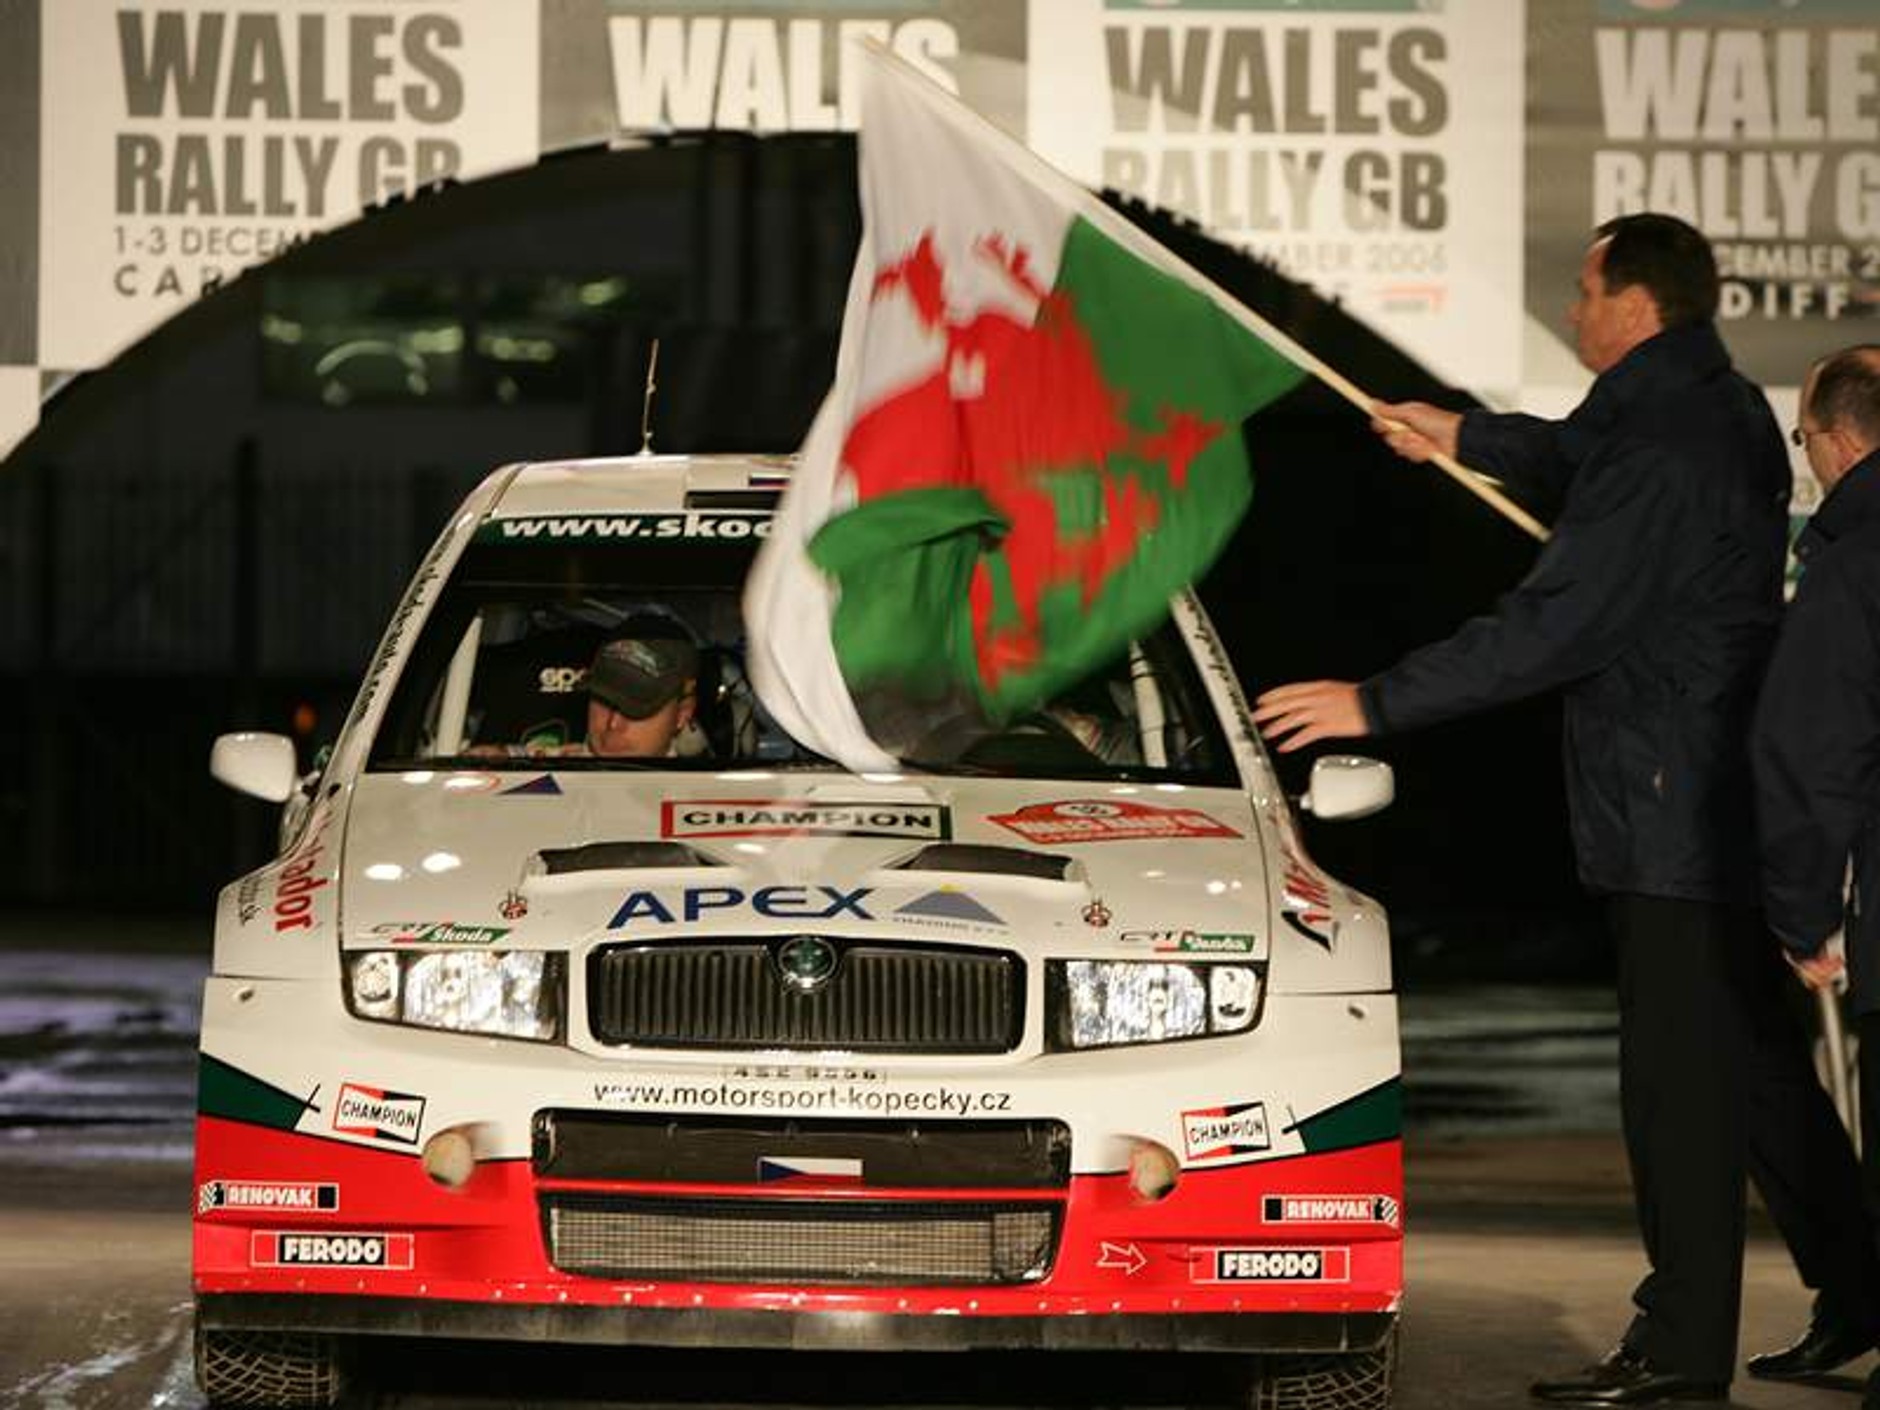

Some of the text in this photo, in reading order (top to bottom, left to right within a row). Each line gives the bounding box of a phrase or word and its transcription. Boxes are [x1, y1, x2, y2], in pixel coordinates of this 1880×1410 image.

[116, 11, 464, 123] WALES
[1103, 27, 1448, 137] WALES
[1597, 29, 1880, 140] WALE
[115, 133, 339, 217] RALLY
[1102, 149, 1447, 232] RALLY GB
[1593, 151, 1822, 239] RALLY
[114, 226, 166, 254] 1-3
[1718, 281, 1849, 320] DIFF
[682, 810, 933, 828] CHAMPION
[607, 886, 876, 929] APEX
[341, 1099, 417, 1128] CHAMPION
[593, 1082, 1013, 1115] www.motorsport-kopecky.cz
[1188, 1118, 1264, 1145] CHAMPION
[228, 1185, 313, 1206] RENOVAK
[1286, 1201, 1371, 1221] RENOVAK
[283, 1237, 382, 1263] FERODO
[1222, 1252, 1320, 1277] FERODO
